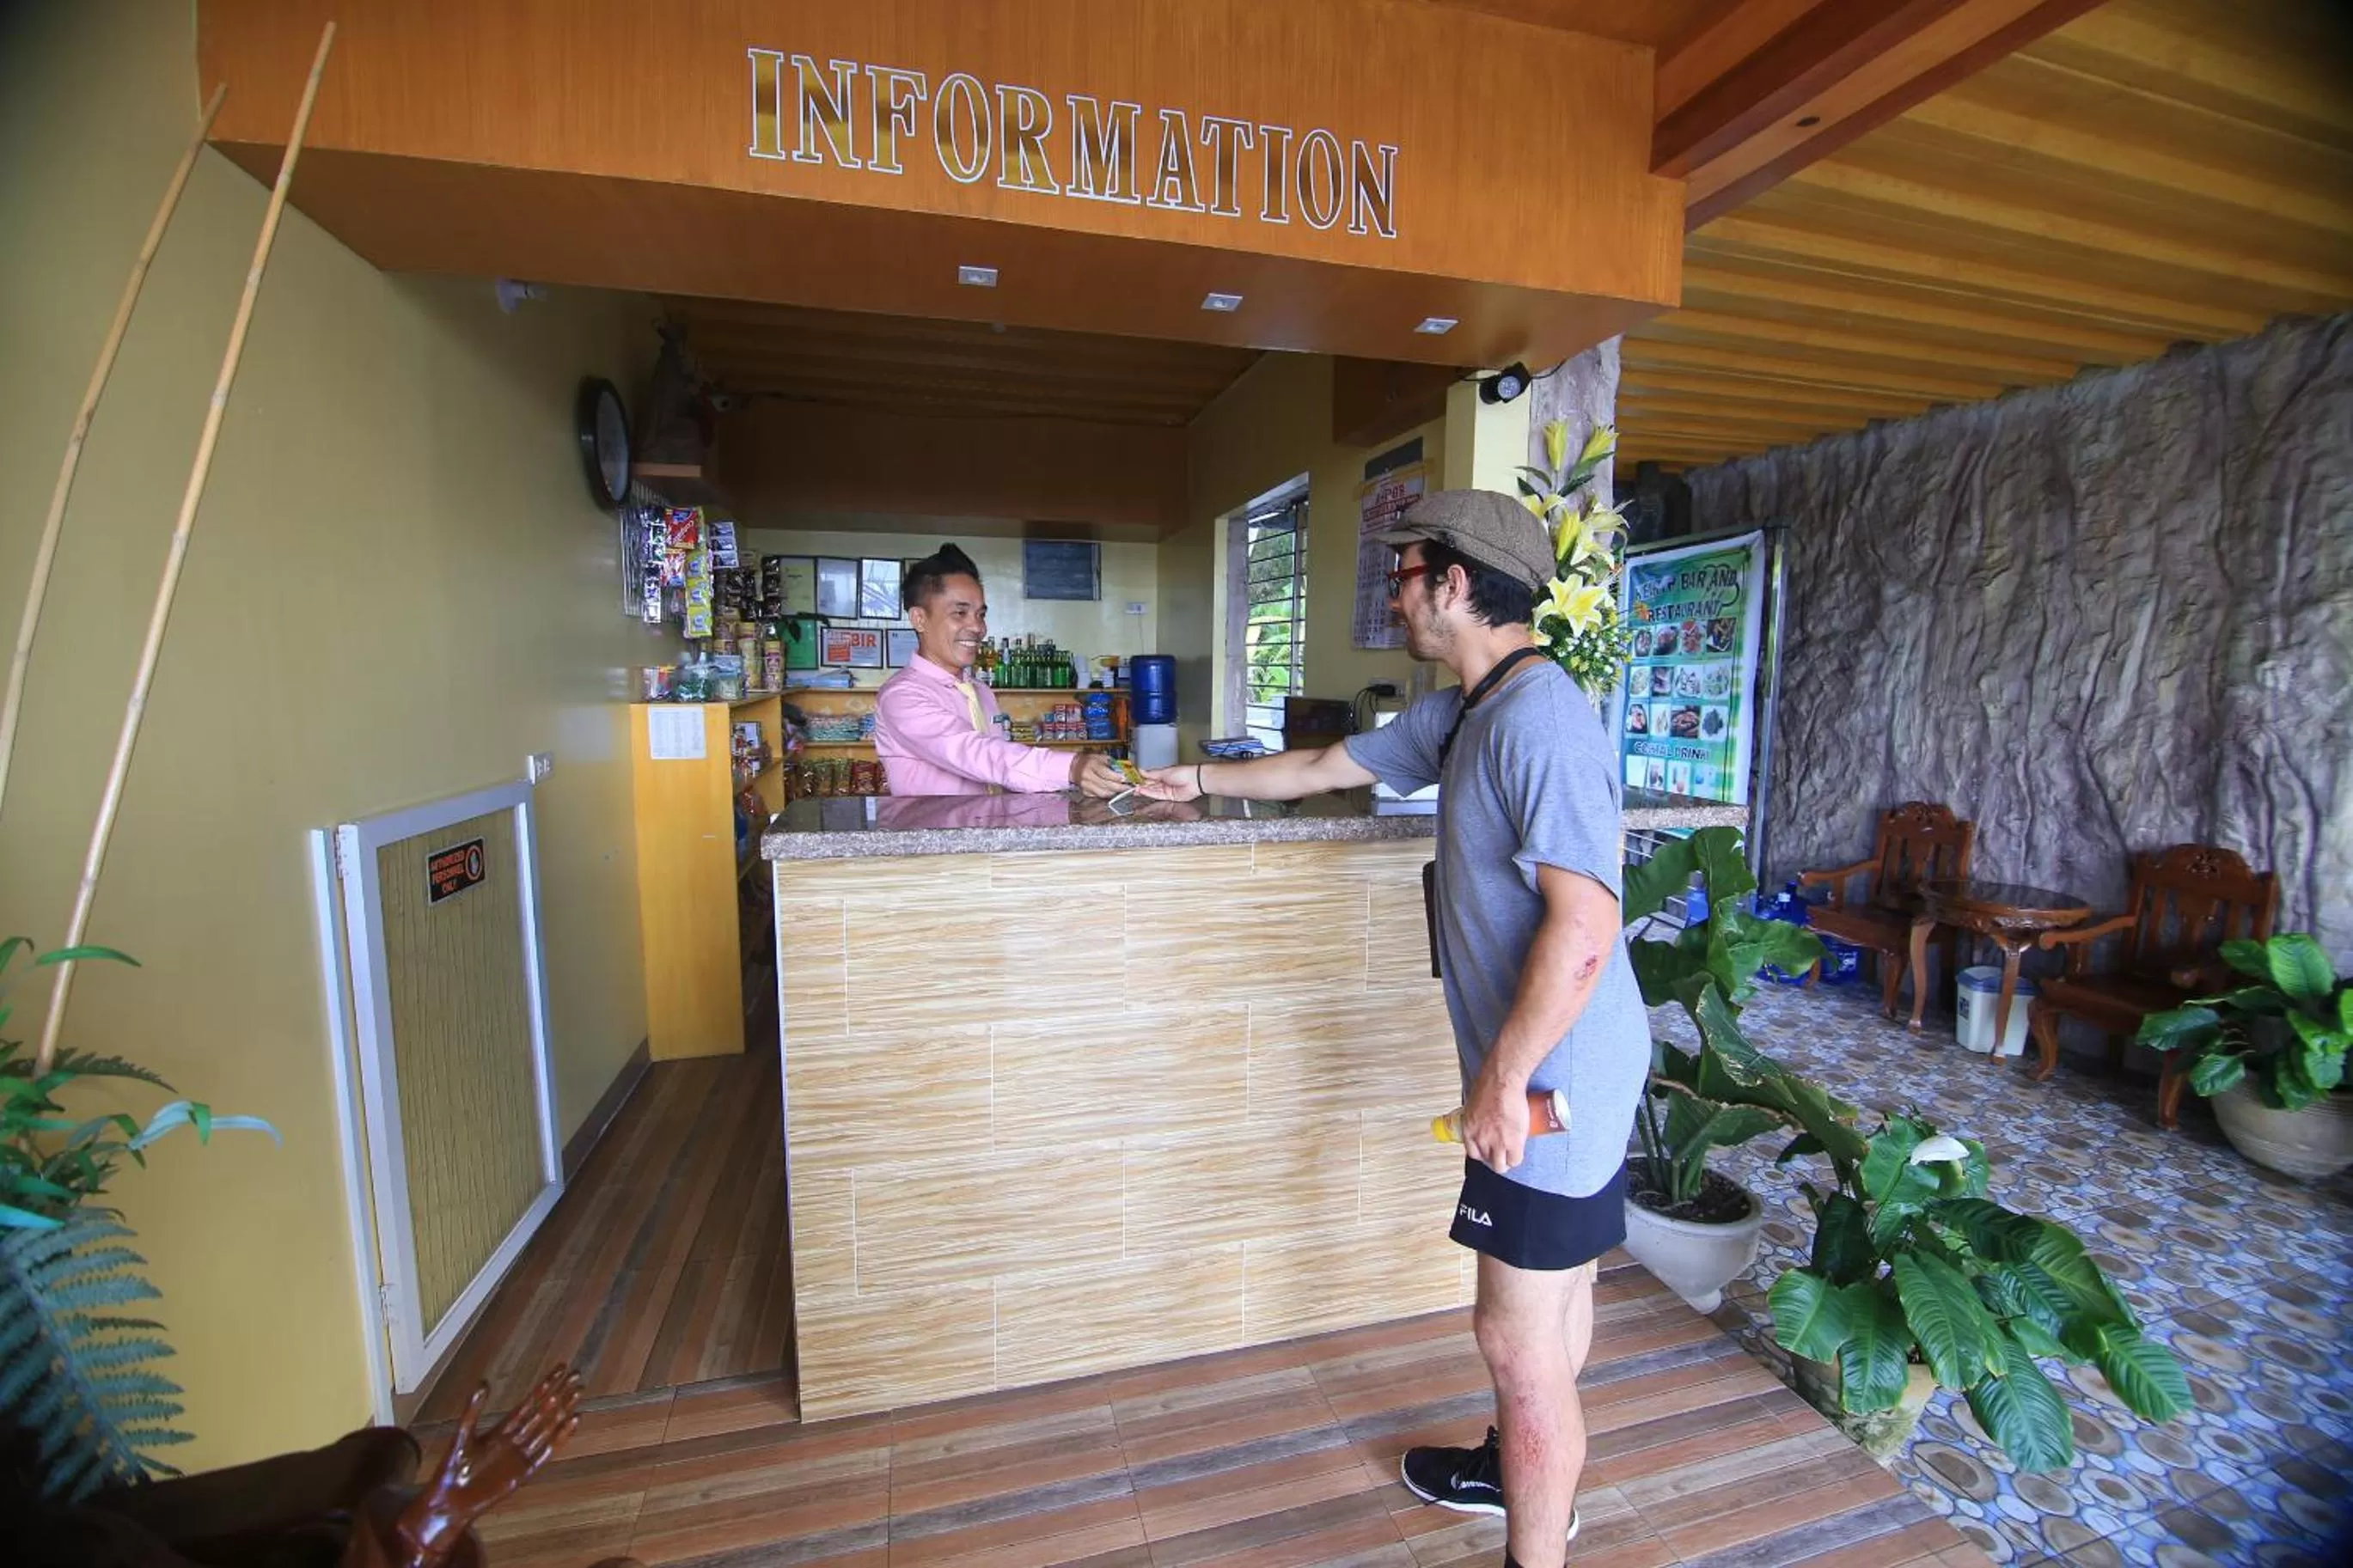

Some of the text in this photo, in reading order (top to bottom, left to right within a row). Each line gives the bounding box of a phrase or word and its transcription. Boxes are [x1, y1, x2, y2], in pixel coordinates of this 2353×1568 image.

[748, 47, 1398, 238] INFORMATION
[1681, 570, 1707, 590] BAR
[1710, 568, 1737, 587] AND
[1648, 600, 1721, 622] RESTAURANT
[851, 632, 877, 647] BIR
[1459, 1203, 1493, 1227] FILA
